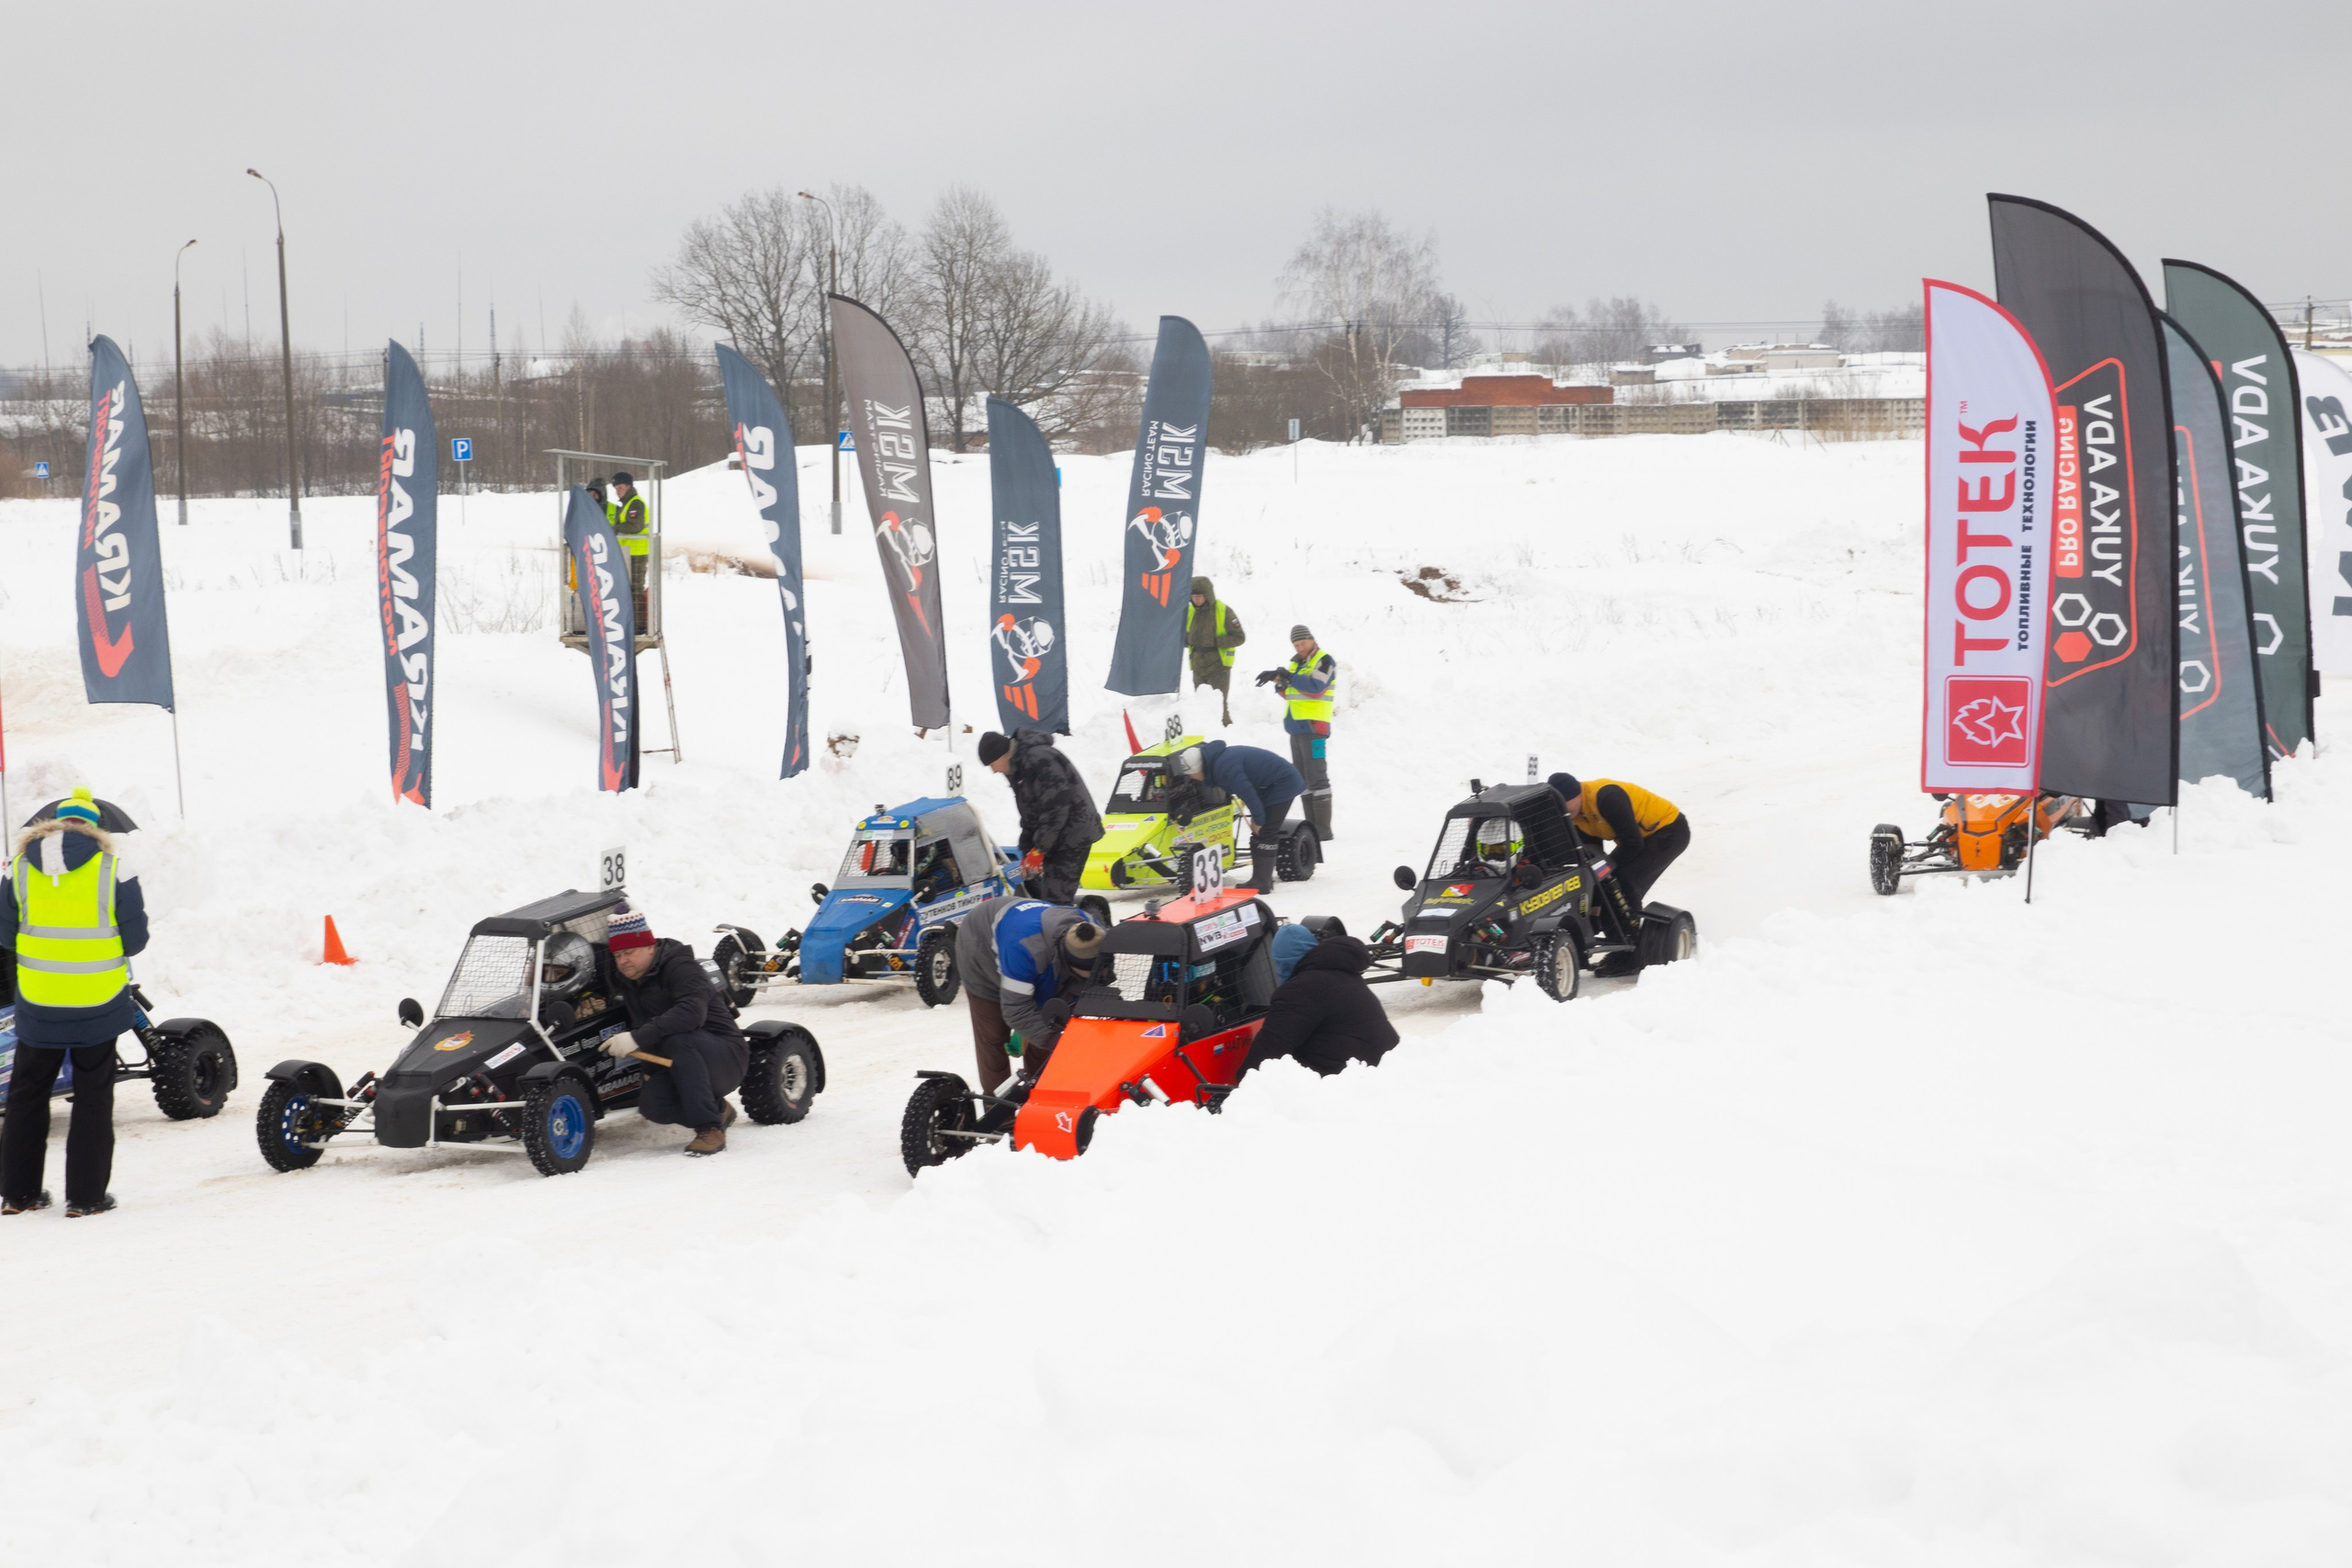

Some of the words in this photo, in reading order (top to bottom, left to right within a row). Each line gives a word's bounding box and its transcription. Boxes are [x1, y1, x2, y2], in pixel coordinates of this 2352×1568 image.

[456, 440, 469, 458] P
[2021, 420, 2036, 533] ТЕХНОЛОГИИ
[2018, 545, 2032, 651] ТОПЛИВНЫЕ
[1167, 714, 1182, 739] 88
[947, 764, 962, 792] 89
[604, 852, 625, 886] 38
[1195, 849, 1221, 894] 33
